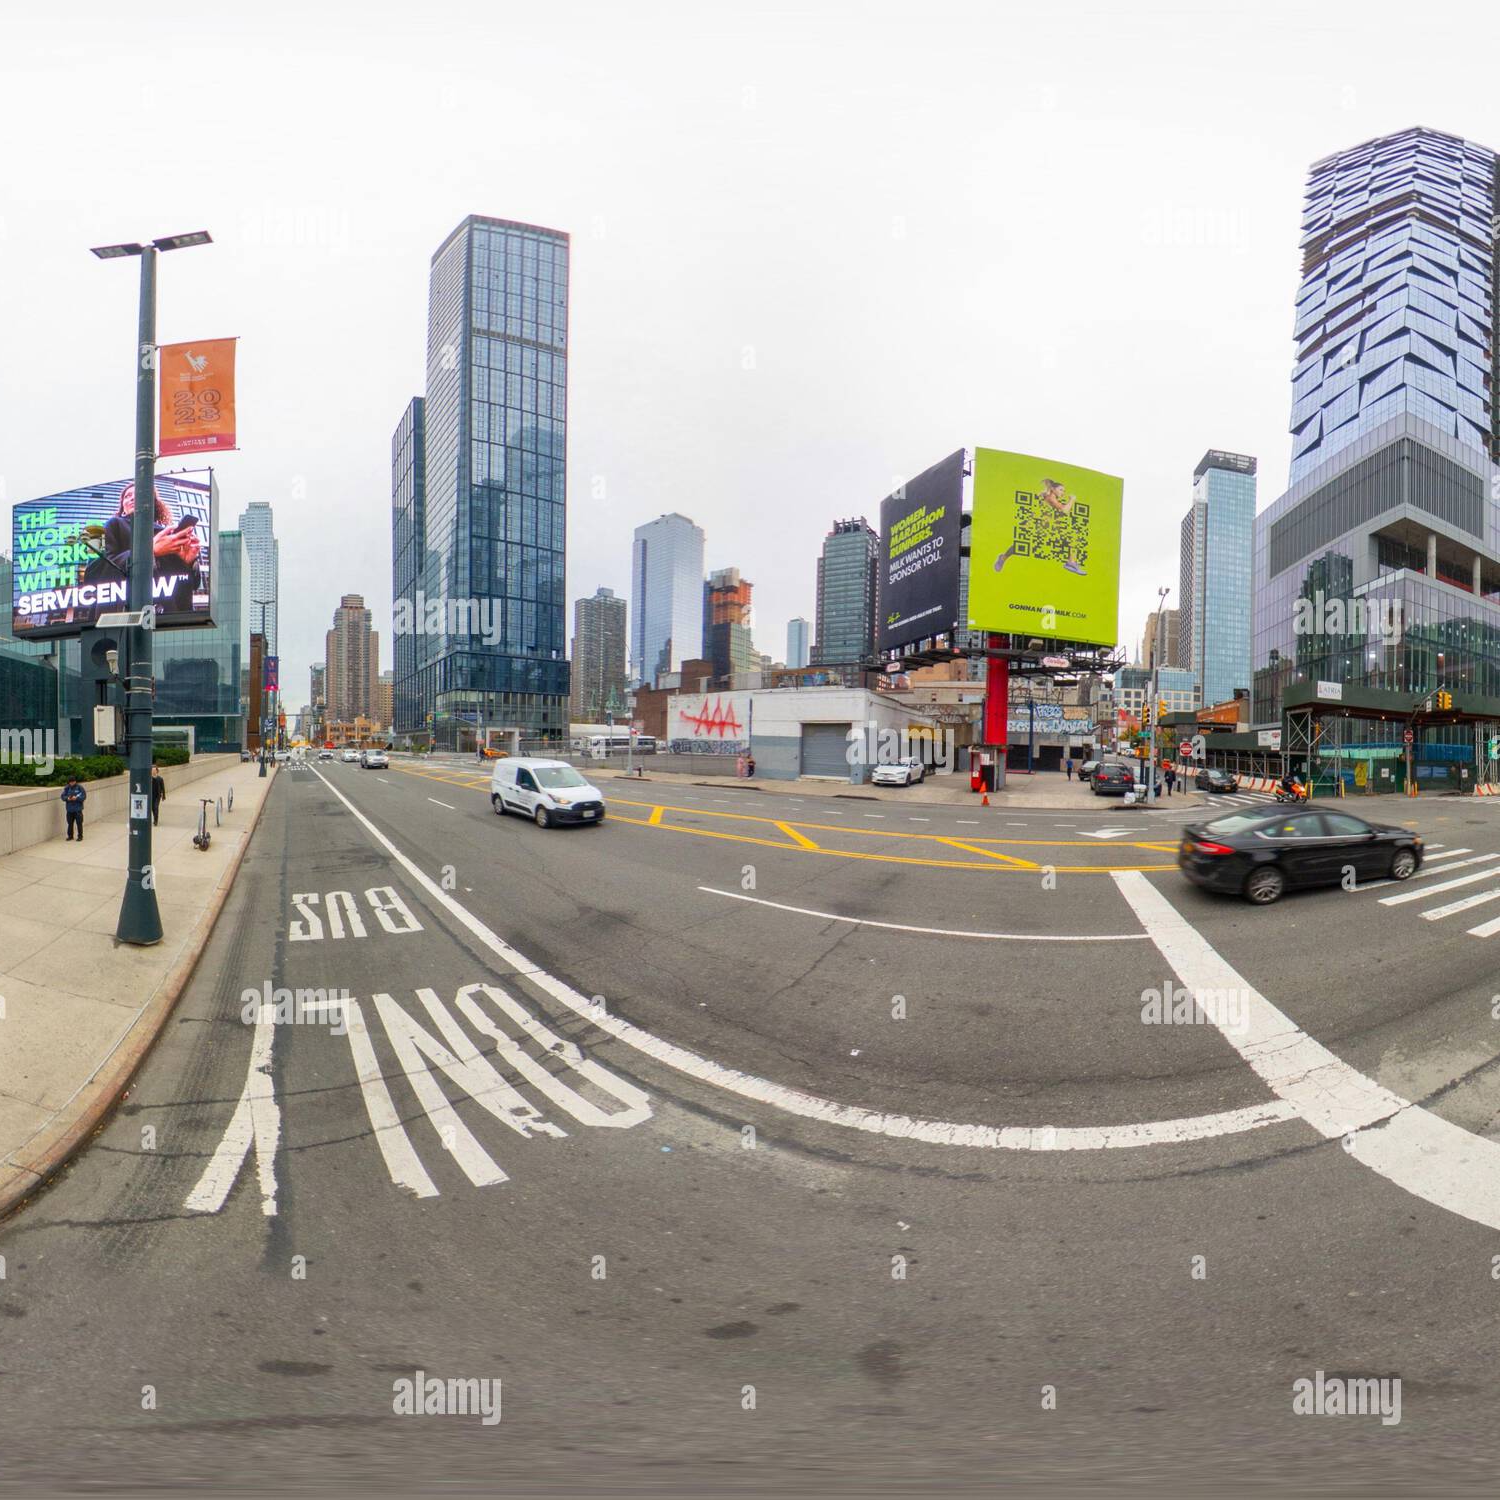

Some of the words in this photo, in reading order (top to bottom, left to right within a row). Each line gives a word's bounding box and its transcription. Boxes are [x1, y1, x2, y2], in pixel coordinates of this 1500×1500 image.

[18, 507, 57, 531] THE
[890, 505, 926, 536] WOMEN
[890, 505, 945, 548] MARATHON
[889, 525, 933, 559] RUNNERS.
[889, 556, 905, 573] MILK
[905, 542, 931, 565] WANTS
[932, 536, 943, 549] TO
[18, 566, 76, 592] WITH
[889, 560, 921, 584] SPONSOR
[289, 886, 424, 942] BUS
[184, 983, 653, 1216] ONLY
